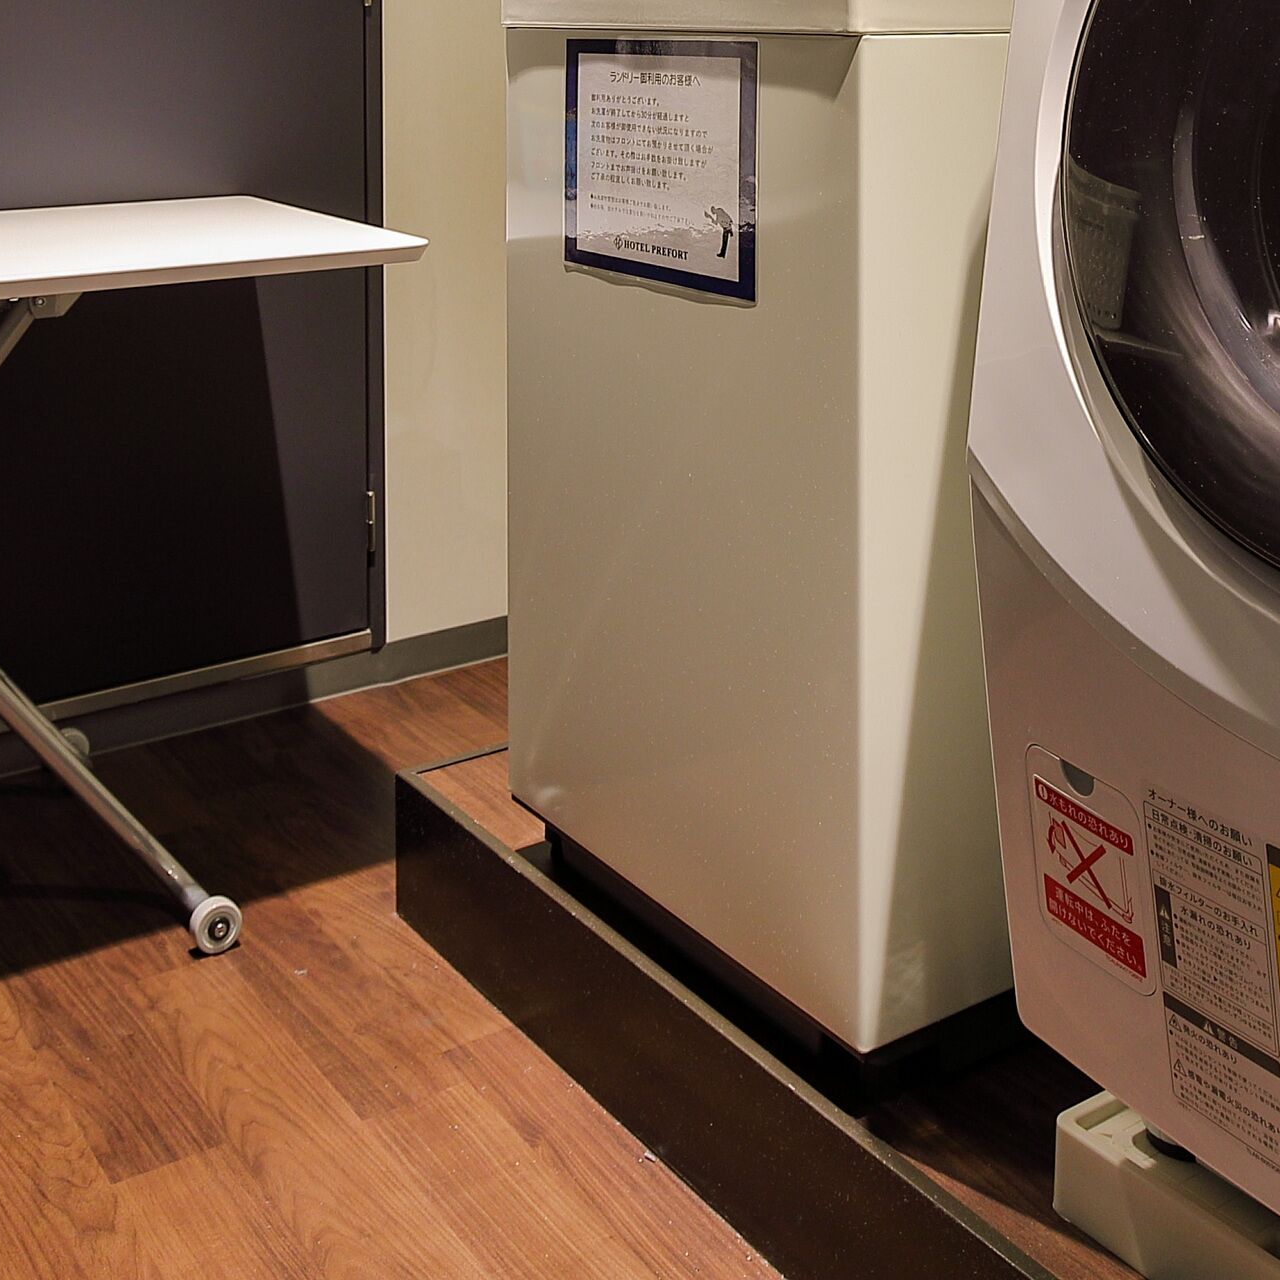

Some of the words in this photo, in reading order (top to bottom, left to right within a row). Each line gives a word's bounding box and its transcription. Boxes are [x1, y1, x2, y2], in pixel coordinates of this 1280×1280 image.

[610, 72, 700, 87] ランドリー御利用のお客様へ
[623, 238, 650, 254] HOTEL
[651, 244, 689, 261] PREFORT
[1049, 792, 1129, 849] 水もれの恐れあり
[1148, 788, 1253, 847] オーナー様へのお願い
[1049, 897, 1143, 972] 開けないでください。
[1055, 885, 1132, 947] 運転中は、ふたを
[1159, 876, 1258, 937] 排水フィルターのお手入れ
[1180, 905, 1251, 950] 水漏れの恐れあり
[1182, 1024, 1237, 1064] 発火の恐れあり
